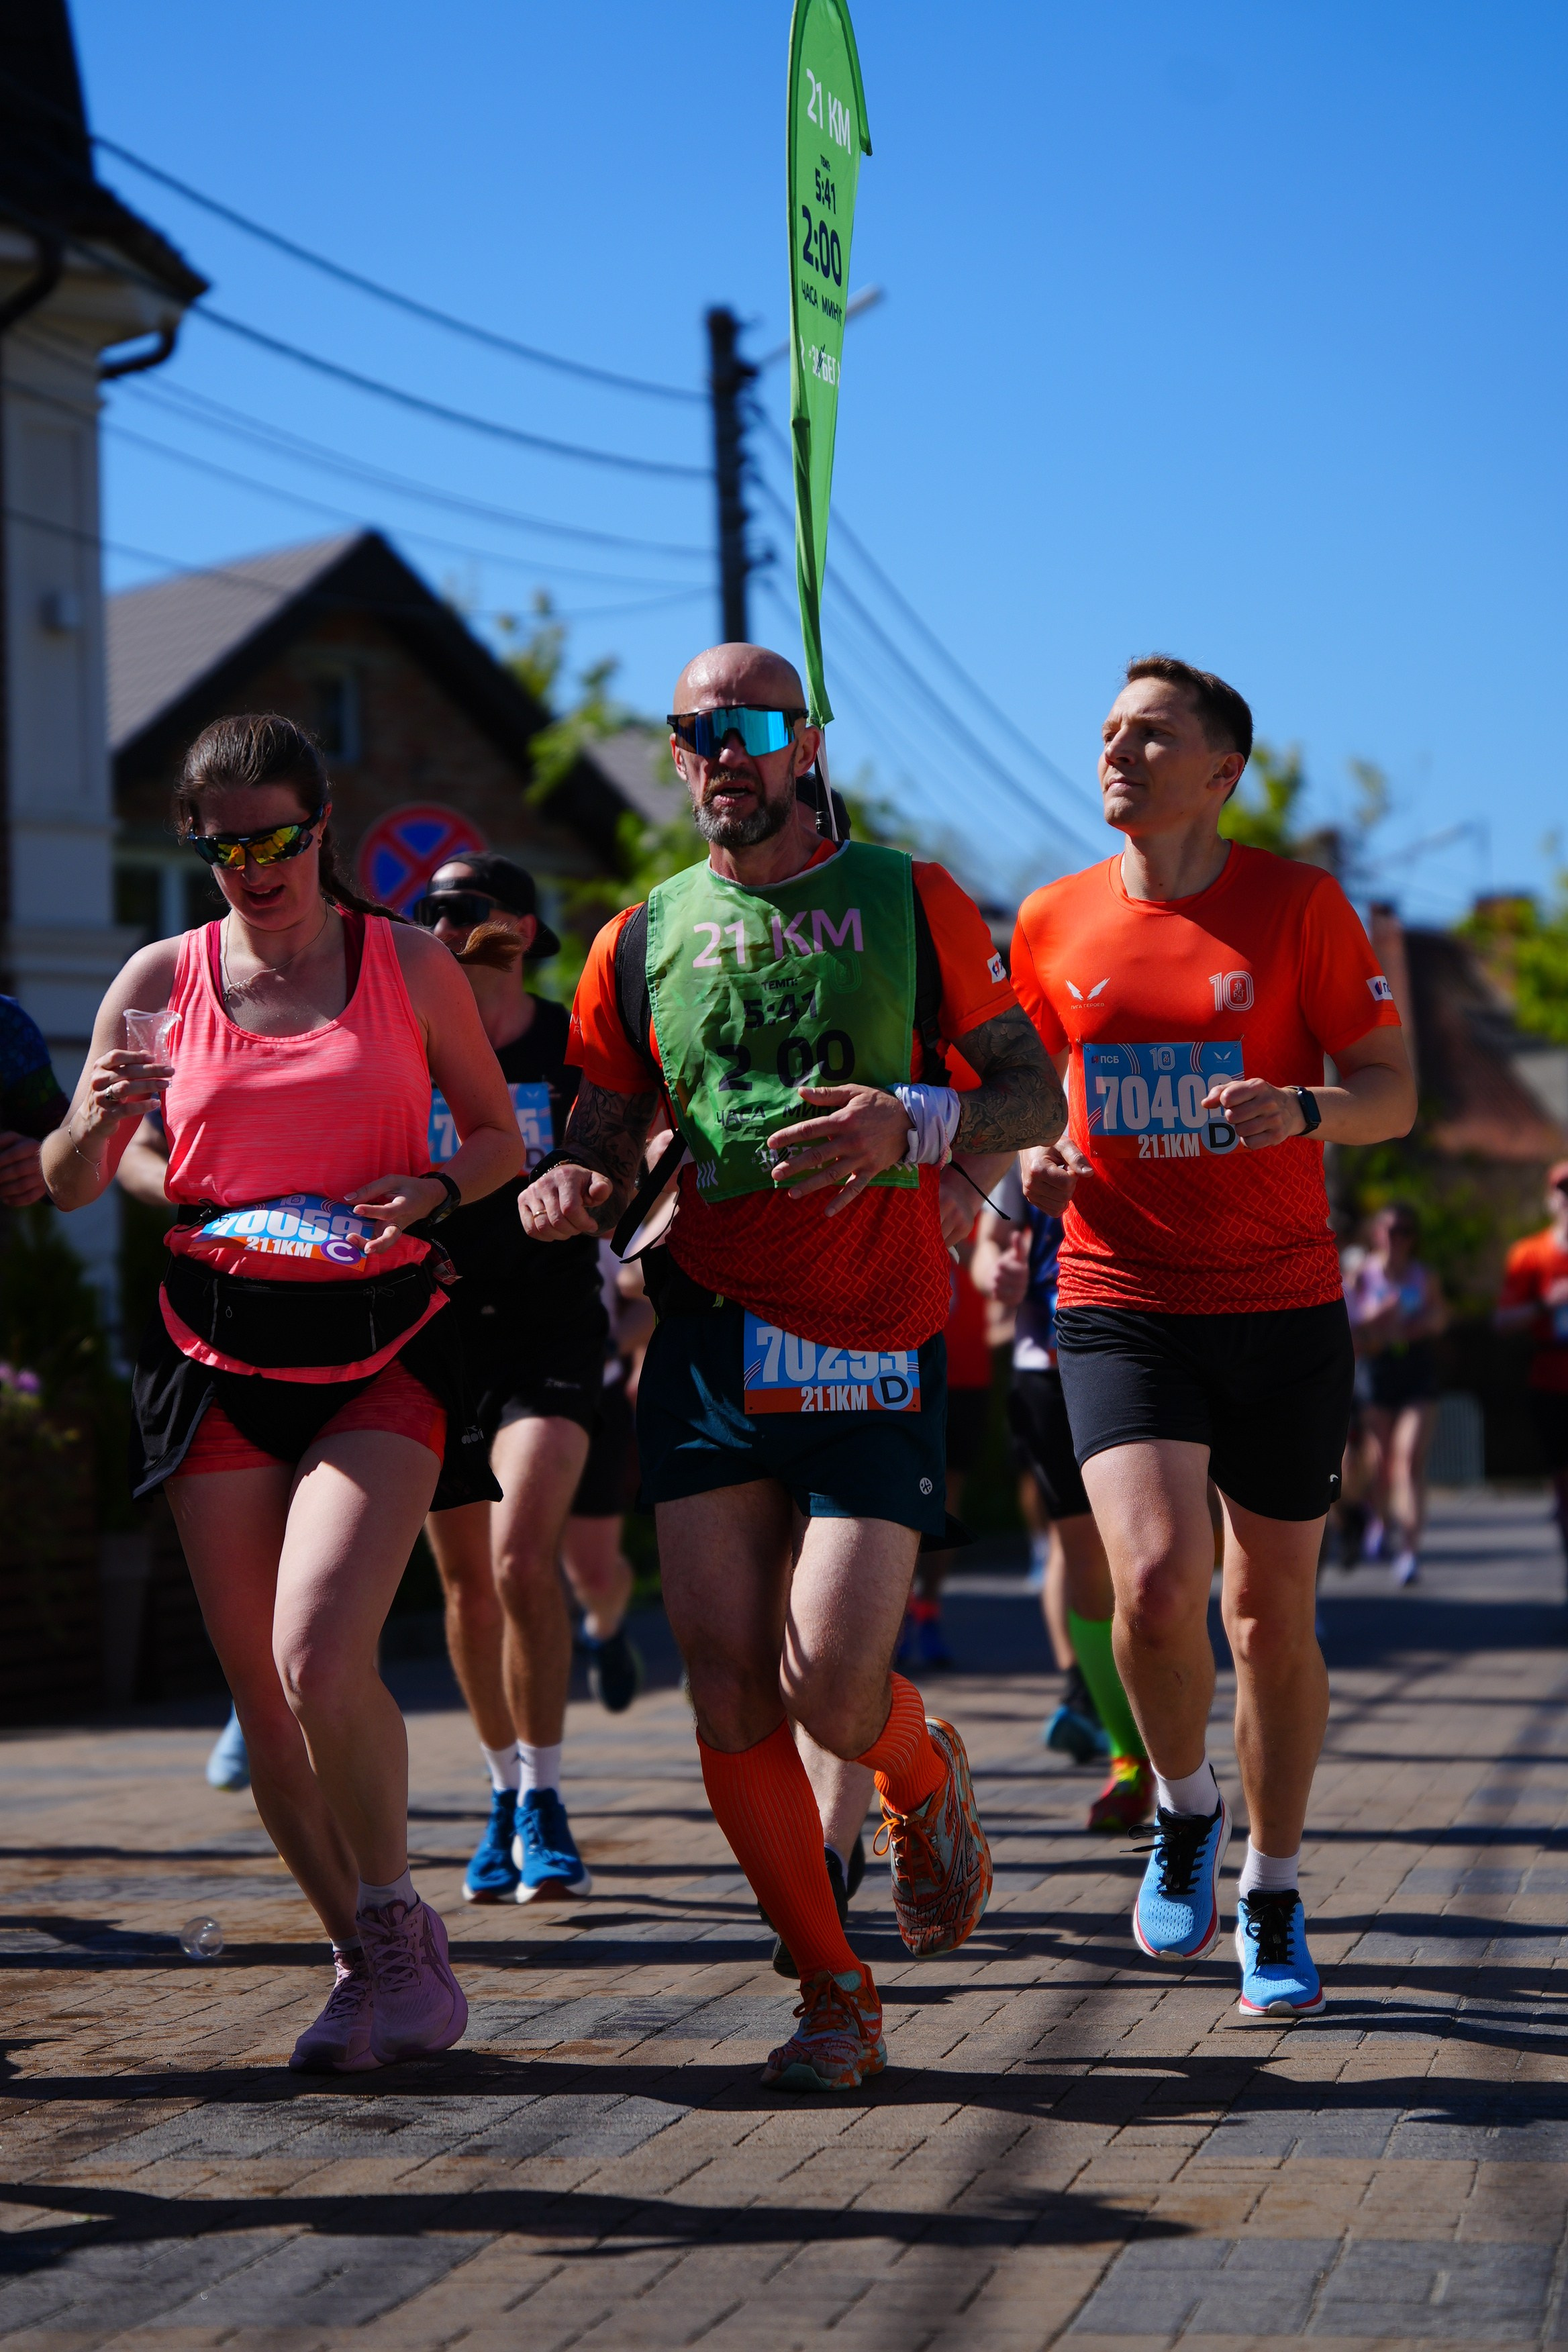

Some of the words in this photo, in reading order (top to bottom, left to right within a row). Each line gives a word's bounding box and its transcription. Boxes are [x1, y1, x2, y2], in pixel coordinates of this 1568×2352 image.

[806, 68, 824, 130] 21
[815, 167, 836, 215] 5:41
[802, 204, 842, 287] 2:00
[801, 279, 819, 309] ЧАСА
[692, 919, 746, 968] 21
[1208, 970, 1255, 1012] 10
[743, 989, 818, 1029] 5:41
[1100, 1055, 1119, 1064] ПСБ
[1149, 1046, 1175, 1071] 10
[716, 1106, 766, 1126] ЧАСА
[782, 1103, 832, 1118] МИН
[1138, 1132, 1200, 1159] 21.1KM
[1208, 1122, 1236, 1148] D
[244, 1236, 313, 1259] 21.1KM
[326, 1241, 354, 1261] C
[801, 1385, 868, 1412] 21.1KM
[879, 1376, 909, 1404] D
